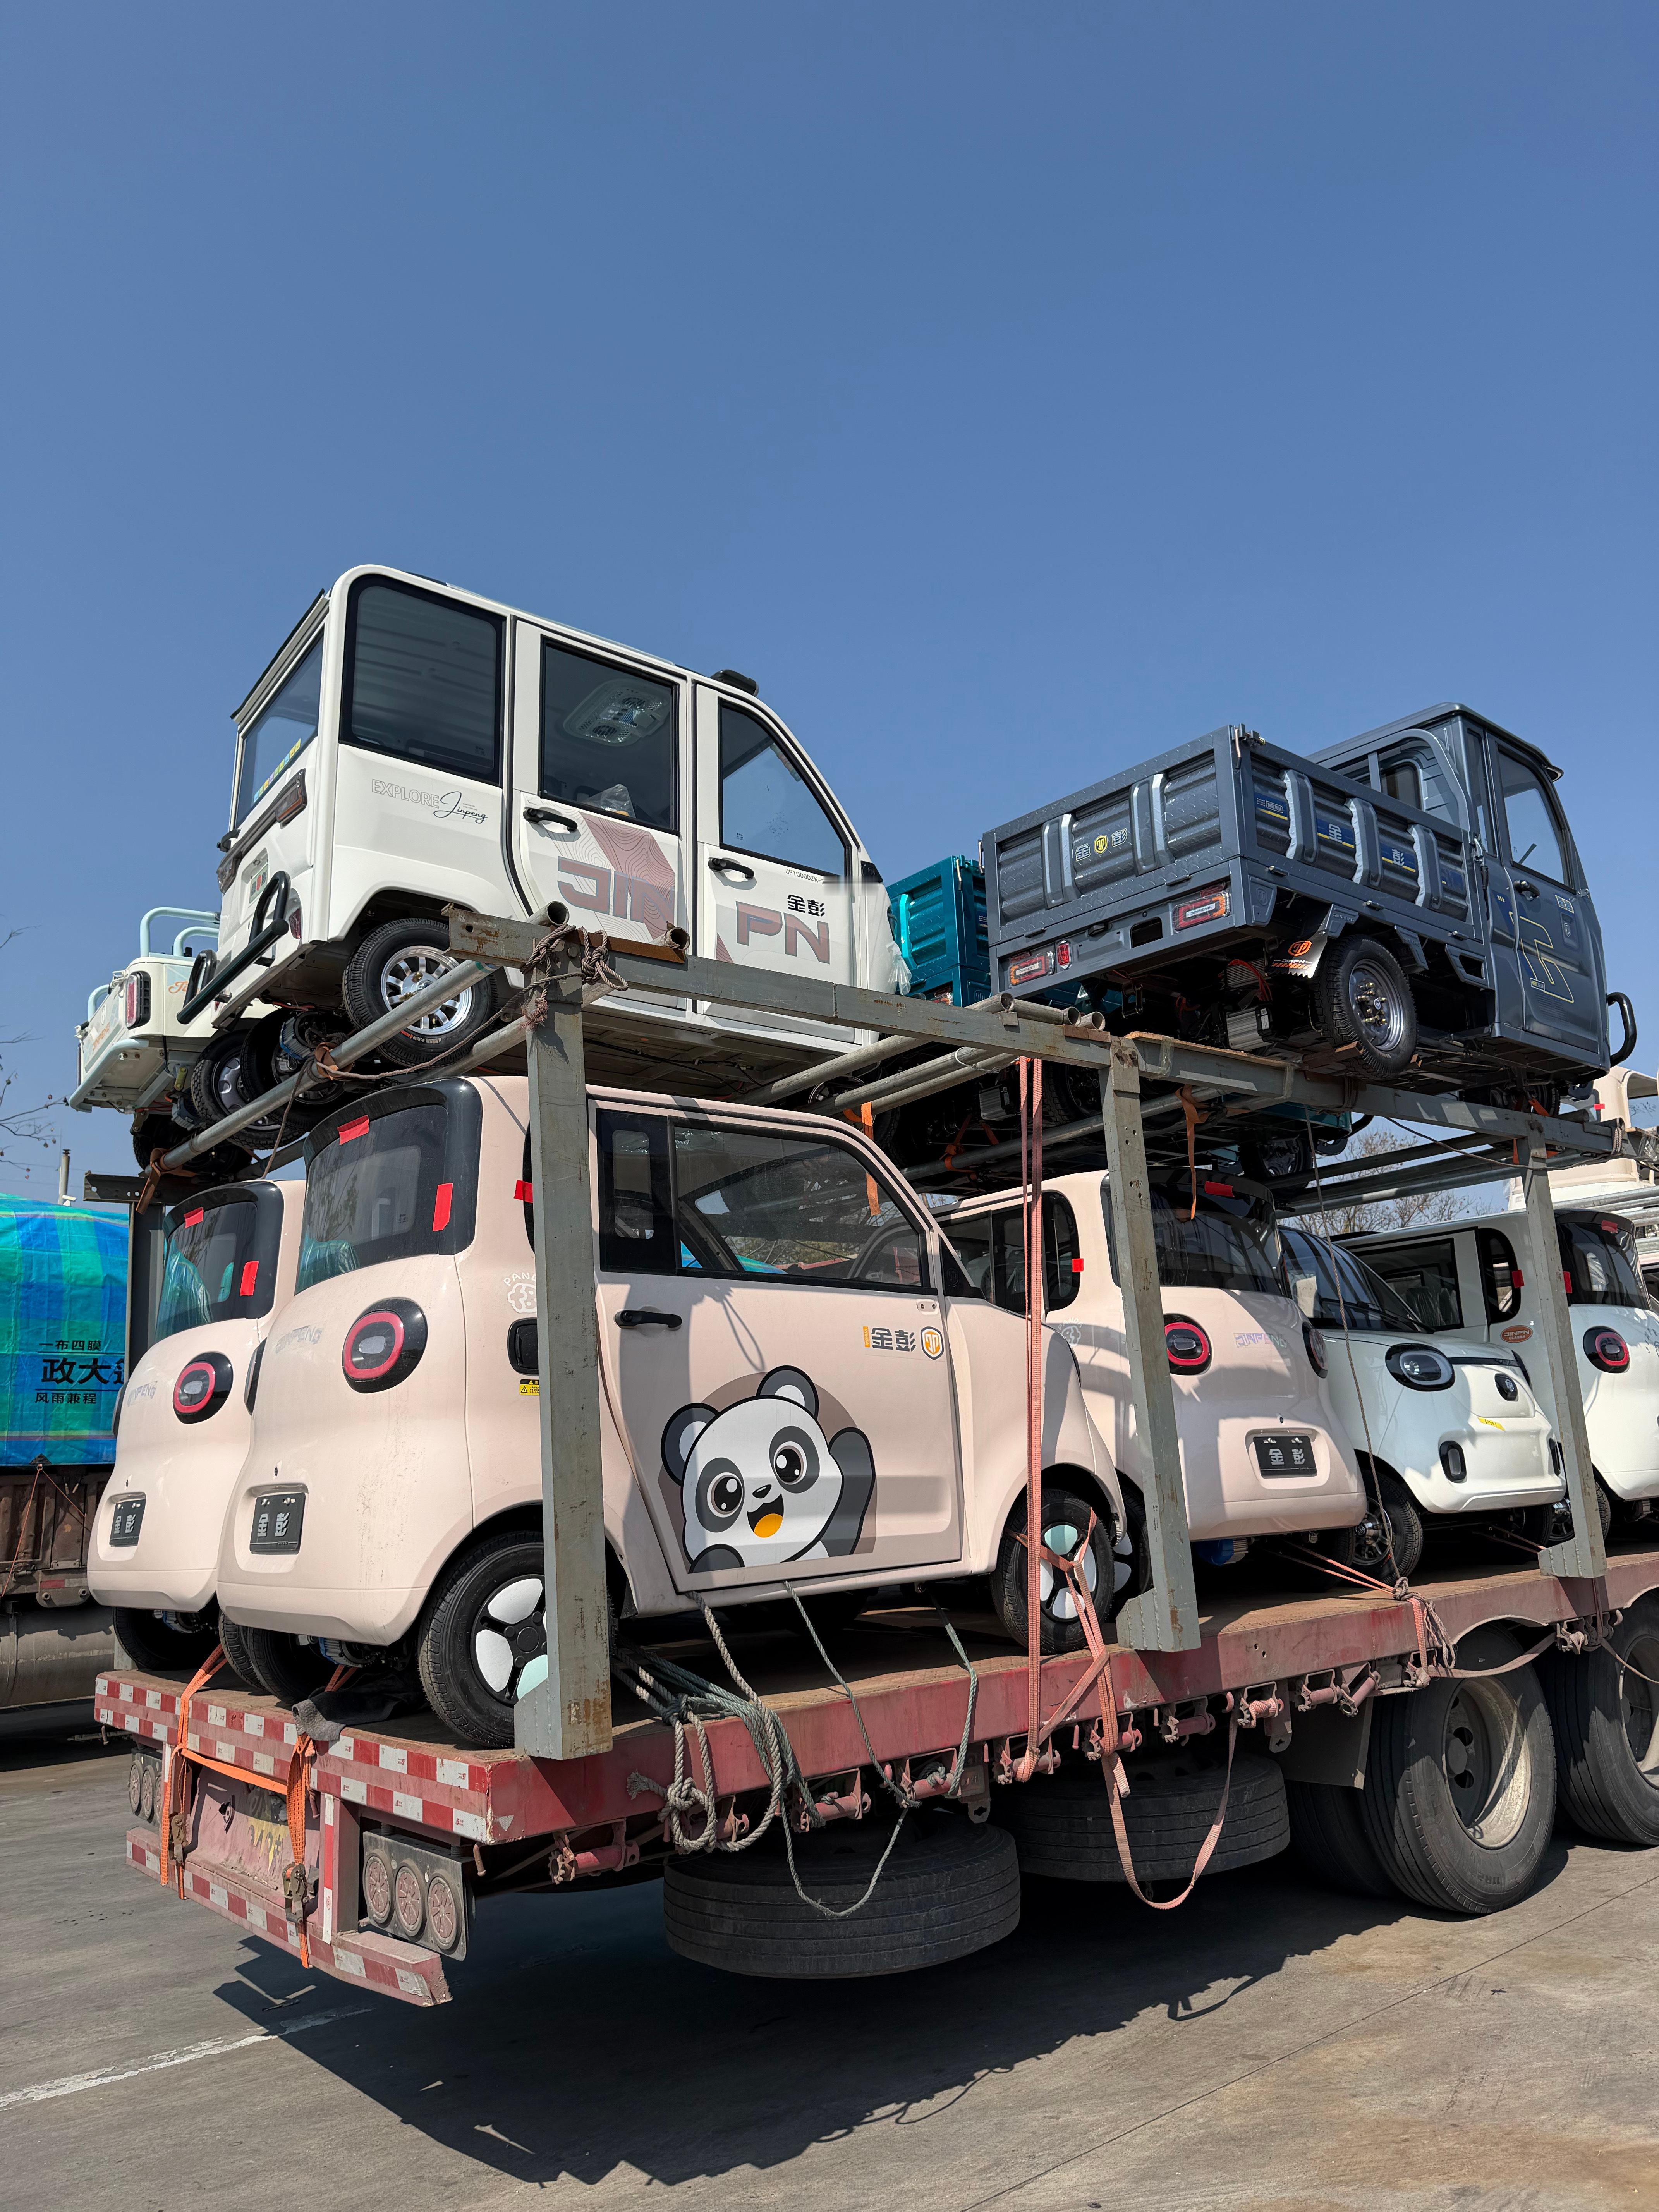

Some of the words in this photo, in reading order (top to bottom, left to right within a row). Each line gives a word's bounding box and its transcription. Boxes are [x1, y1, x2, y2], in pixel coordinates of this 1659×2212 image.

[372, 779, 439, 808] EXPLORE
[433, 791, 488, 824] Jinpeng
[1329, 824, 1342, 843] 金
[1392, 848, 1405, 866] 彭
[787, 895, 825, 917] 金彭
[736, 901, 830, 964] PN
[1058, 1317, 1083, 1330] PANDA
[40, 1340, 101, 1351] 一布四膜
[871, 1328, 916, 1352] 金彭
[35, 1393, 97, 1404] 风雨兼程
[1269, 1448, 1305, 1465] 金彭
[114, 1514, 136, 1534] 金彭
[257, 1512, 290, 1537] 金彭
